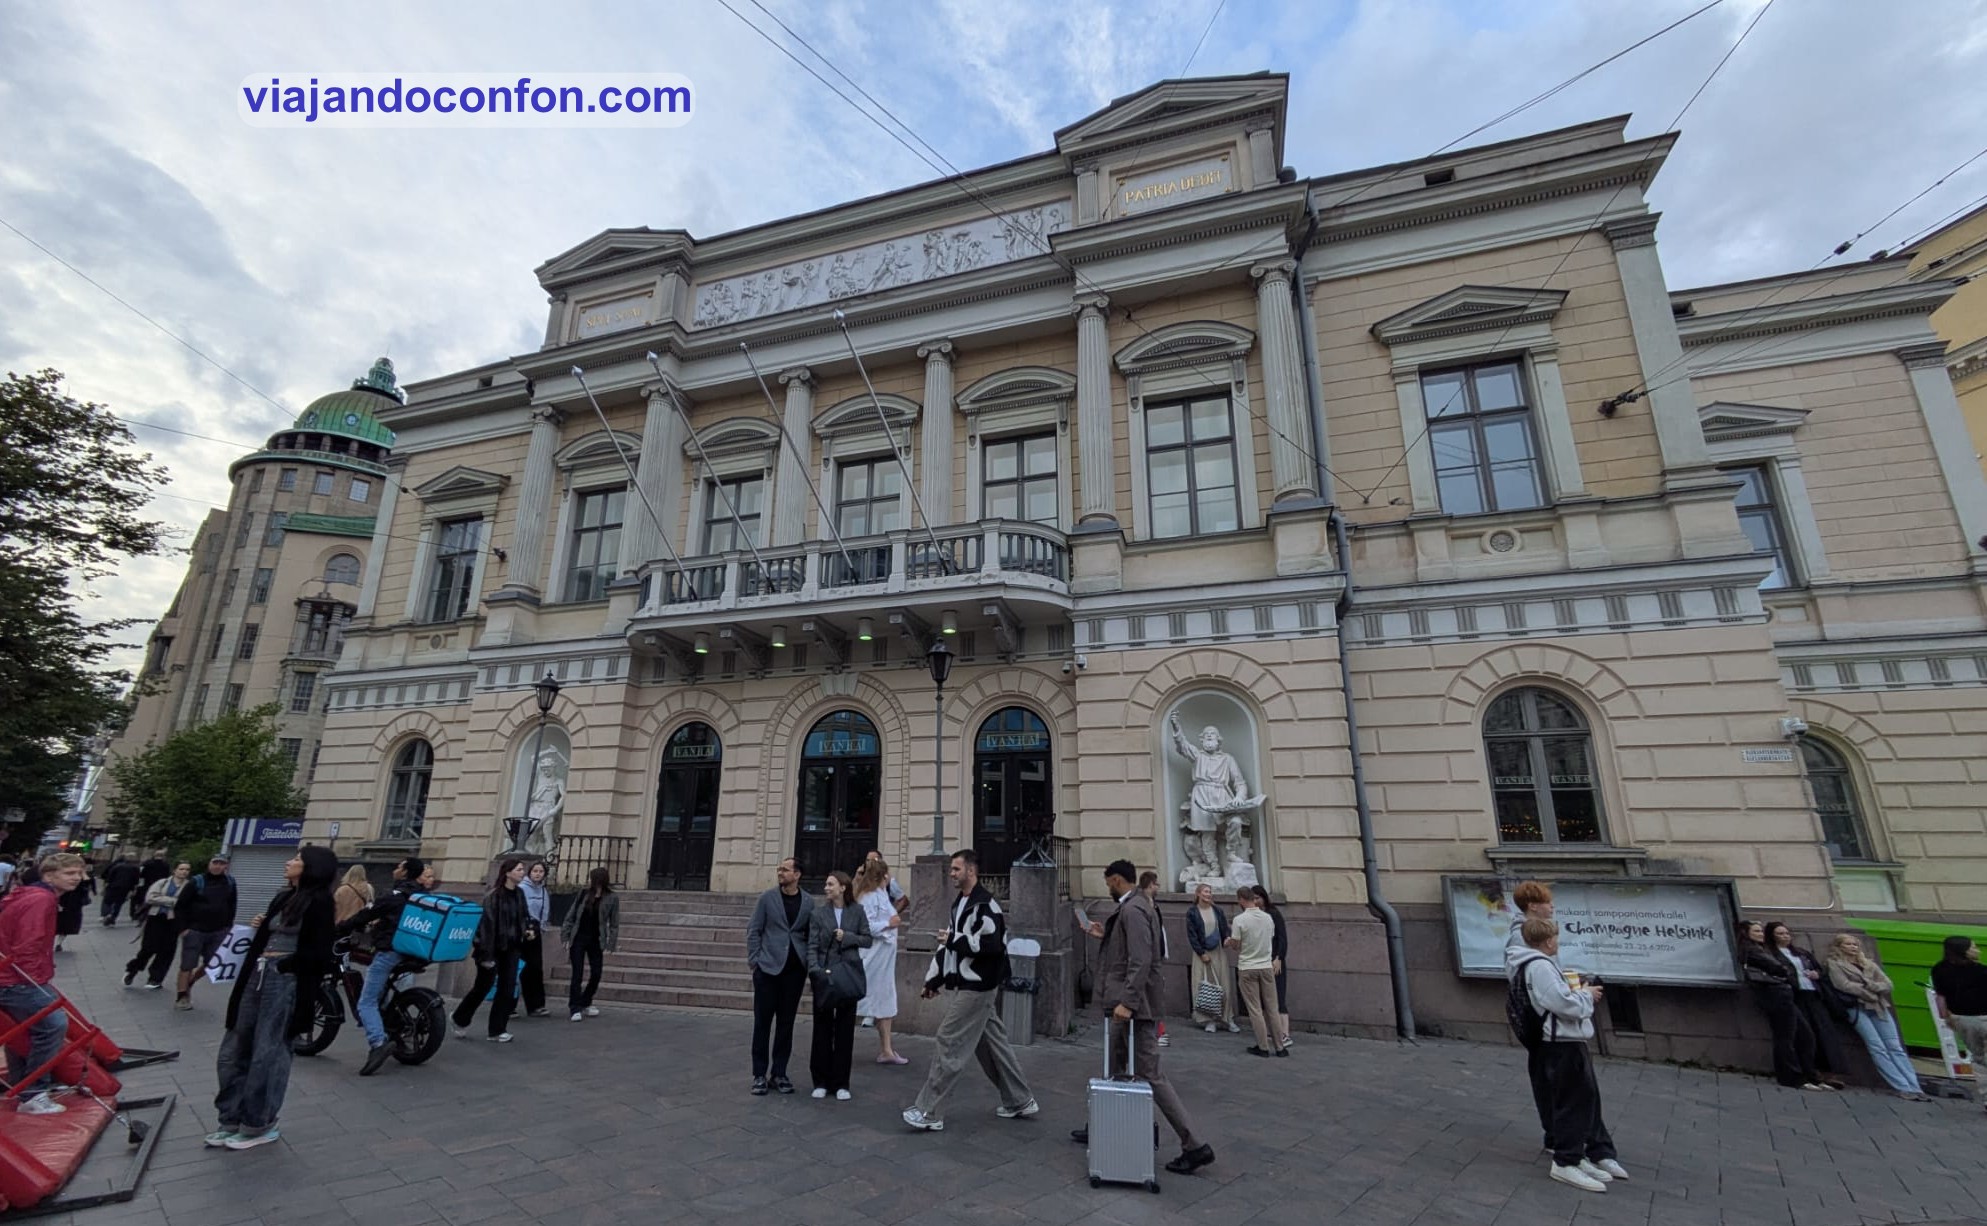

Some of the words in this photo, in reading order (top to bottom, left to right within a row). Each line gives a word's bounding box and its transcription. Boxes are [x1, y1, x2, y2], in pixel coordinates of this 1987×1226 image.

[1124, 182, 1177, 203] PATRIA
[403, 915, 432, 934] Wolt
[448, 926, 474, 940] Wolt
[1565, 921, 1650, 940] Champagne
[1655, 924, 1714, 940] Helsinki
